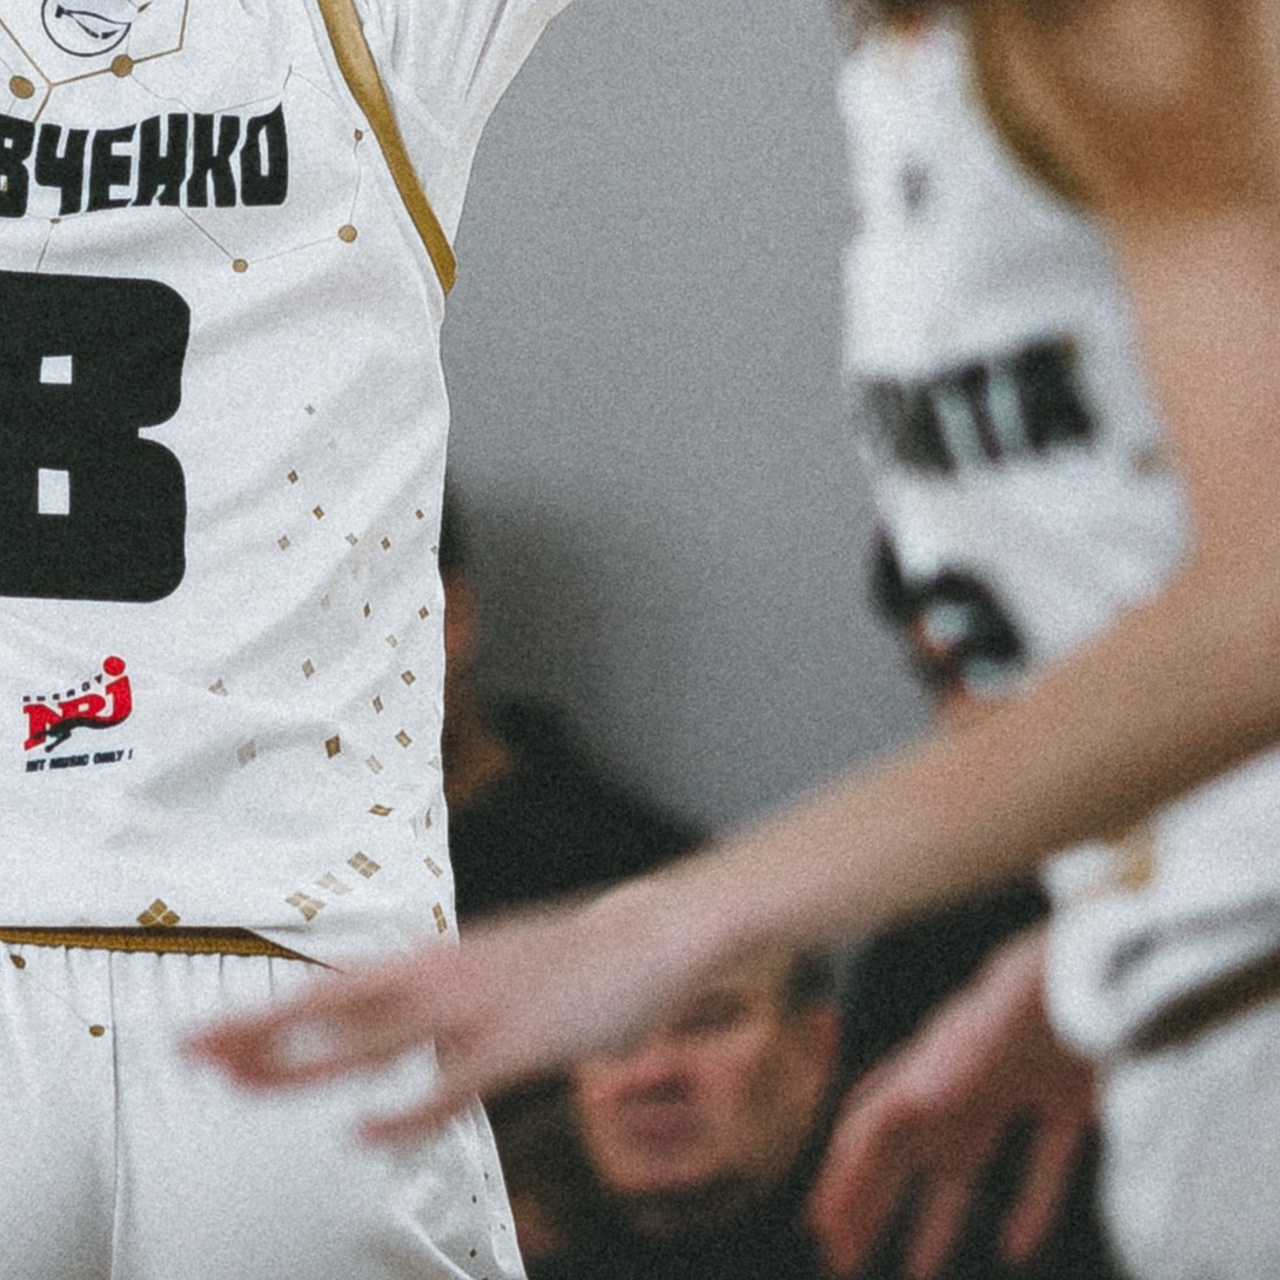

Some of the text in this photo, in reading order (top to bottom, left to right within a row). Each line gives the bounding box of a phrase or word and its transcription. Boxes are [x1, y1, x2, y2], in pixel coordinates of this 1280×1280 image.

[25, 758, 46, 773] HIT
[49, 753, 89, 769] MUSIC
[93, 749, 124, 765] ONLY
